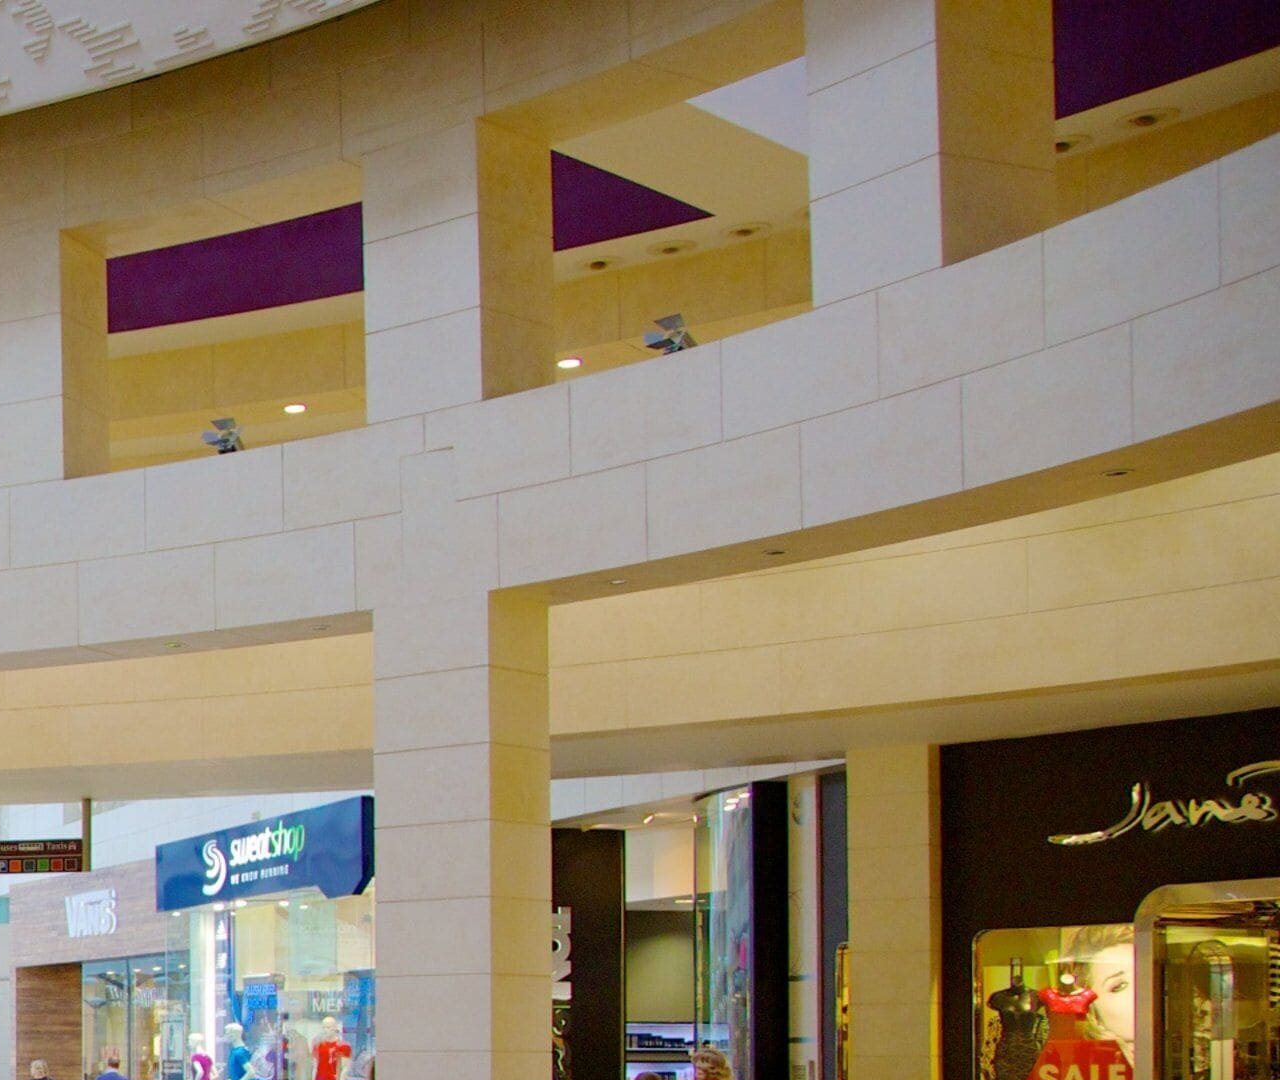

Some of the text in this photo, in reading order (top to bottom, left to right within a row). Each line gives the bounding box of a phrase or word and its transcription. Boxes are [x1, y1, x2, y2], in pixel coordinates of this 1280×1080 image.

[46, 841, 68, 851] Taxis
[229, 820, 305, 867] sweatshop
[65, 888, 117, 938] VANS
